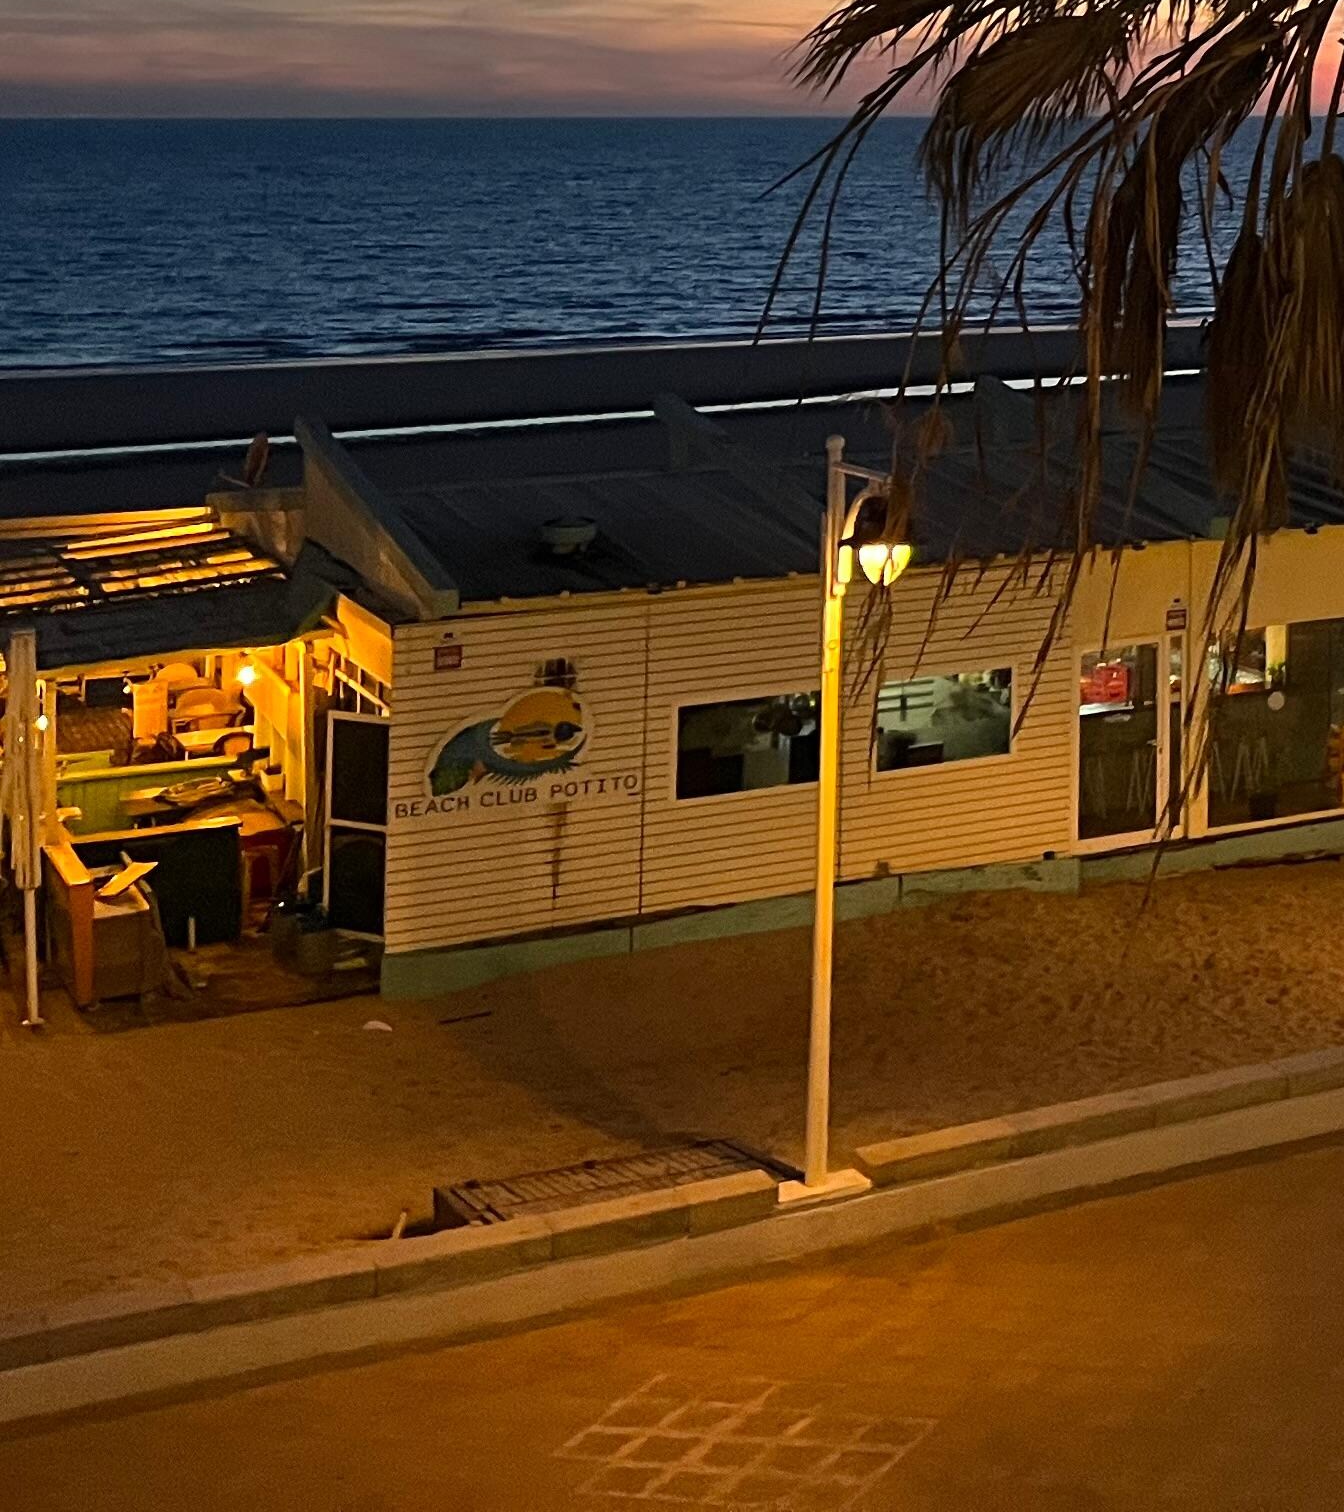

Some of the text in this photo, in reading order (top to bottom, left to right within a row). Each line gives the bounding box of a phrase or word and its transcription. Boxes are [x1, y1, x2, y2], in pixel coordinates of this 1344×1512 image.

[395, 774, 638, 819] BEACH CLUB POTITO
